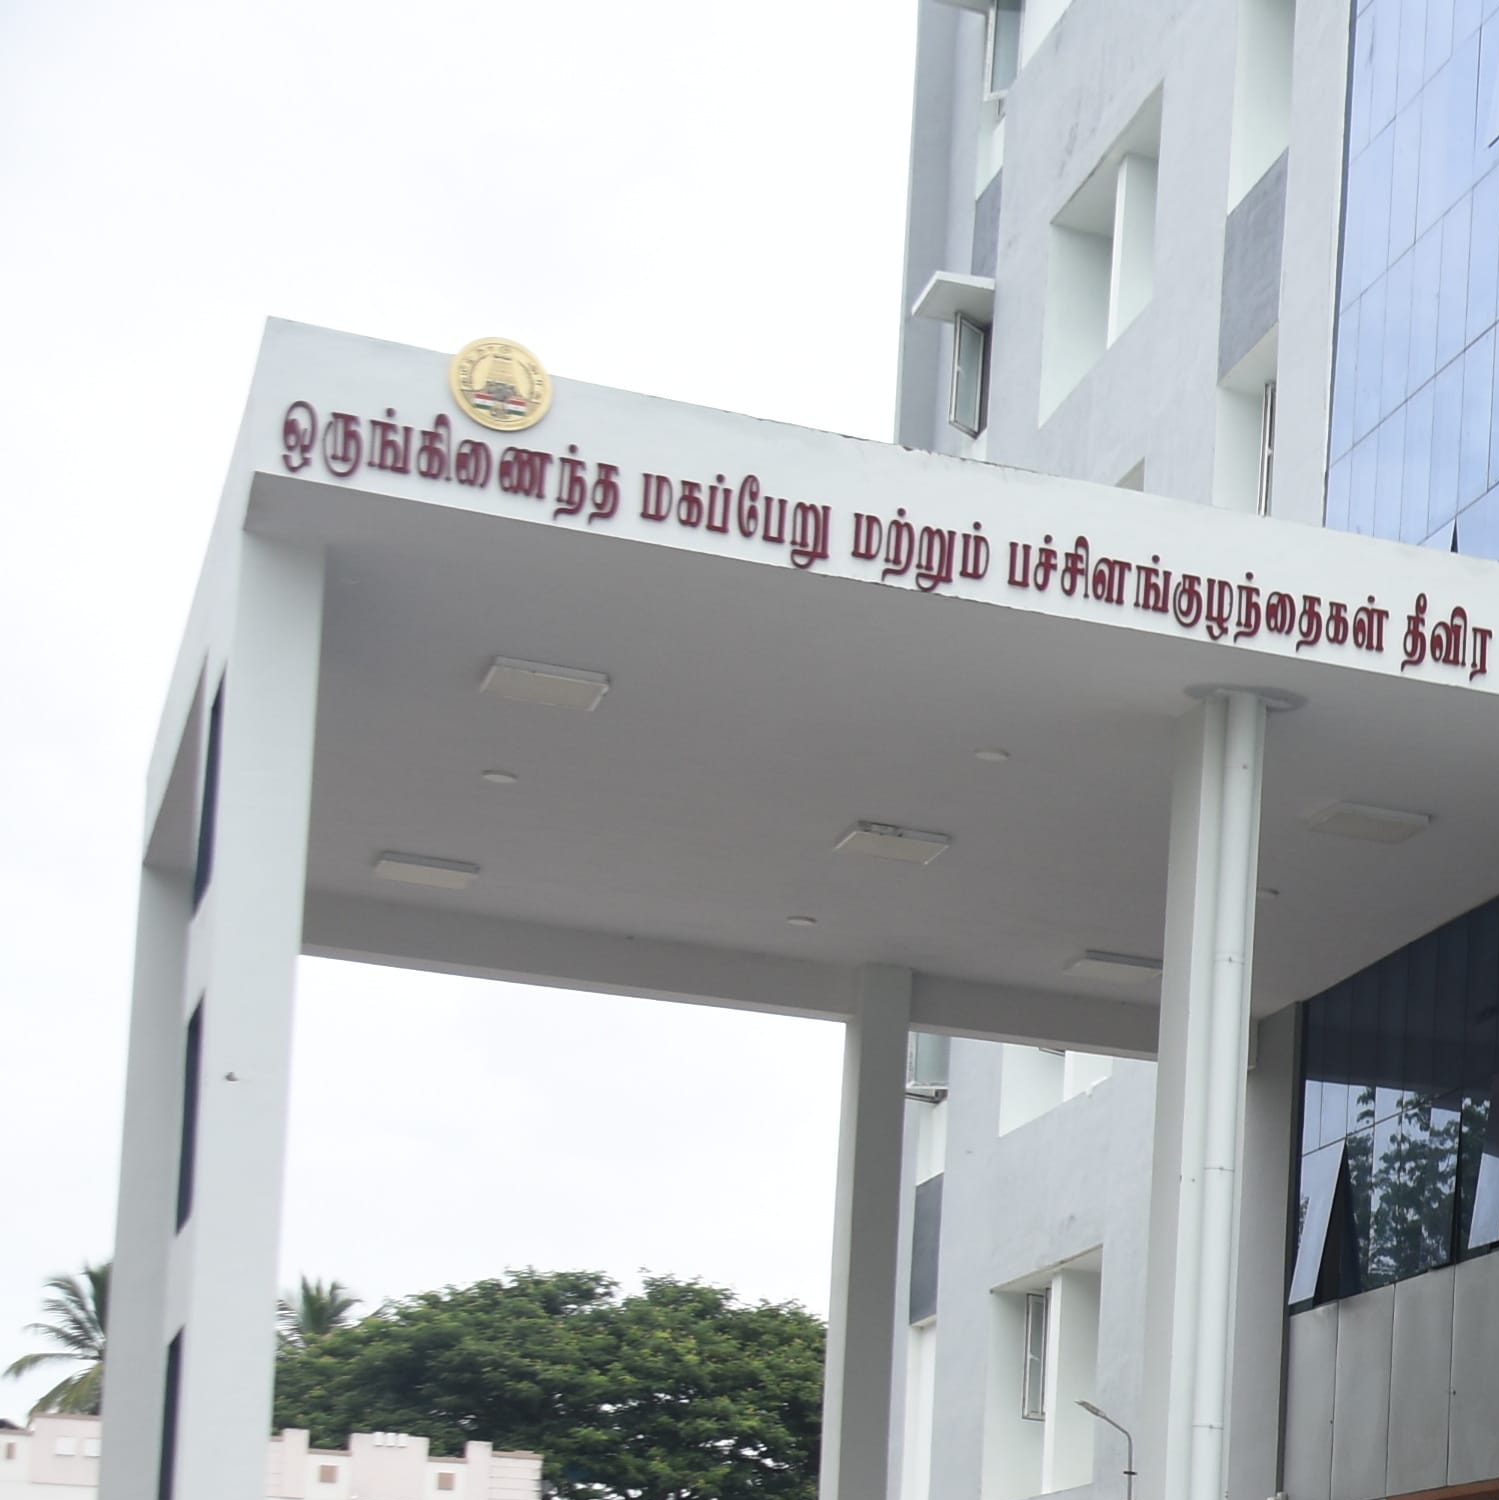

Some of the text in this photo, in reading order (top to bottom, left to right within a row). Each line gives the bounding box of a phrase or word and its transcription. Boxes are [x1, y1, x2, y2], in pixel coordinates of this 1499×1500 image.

[281, 400, 621, 524] ஒருங்கிணைந்த
[640, 473, 831, 569] மகப்பேறு
[851, 508, 990, 592] மற்றும்
[1008, 534, 1389, 653] பச்சிளங்குழந்தைகள்
[1399, 592, 1493, 681] தீவிர
